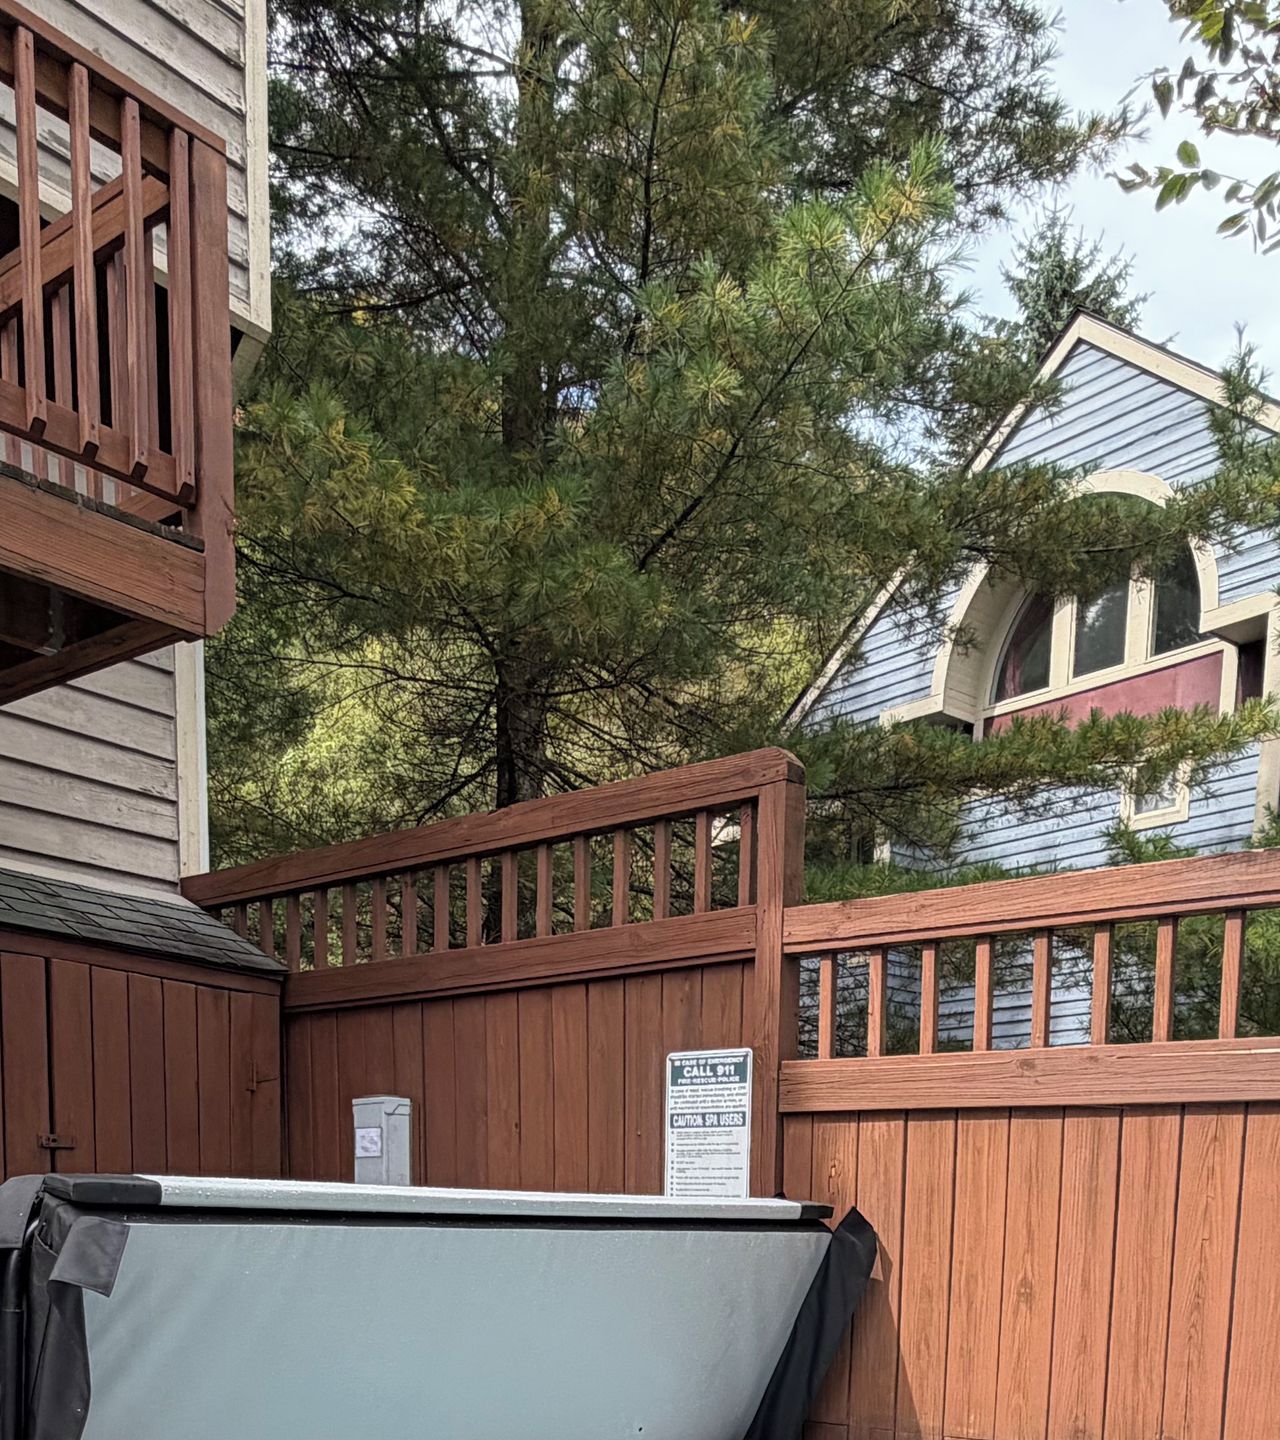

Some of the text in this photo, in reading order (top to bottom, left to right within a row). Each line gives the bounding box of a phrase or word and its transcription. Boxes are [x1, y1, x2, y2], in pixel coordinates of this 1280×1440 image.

[707, 1057, 744, 1065] EMERGENCY
[684, 1064, 735, 1077] CALL 911
[705, 1113, 719, 1126] SPA
[720, 1113, 743, 1126] USERS
